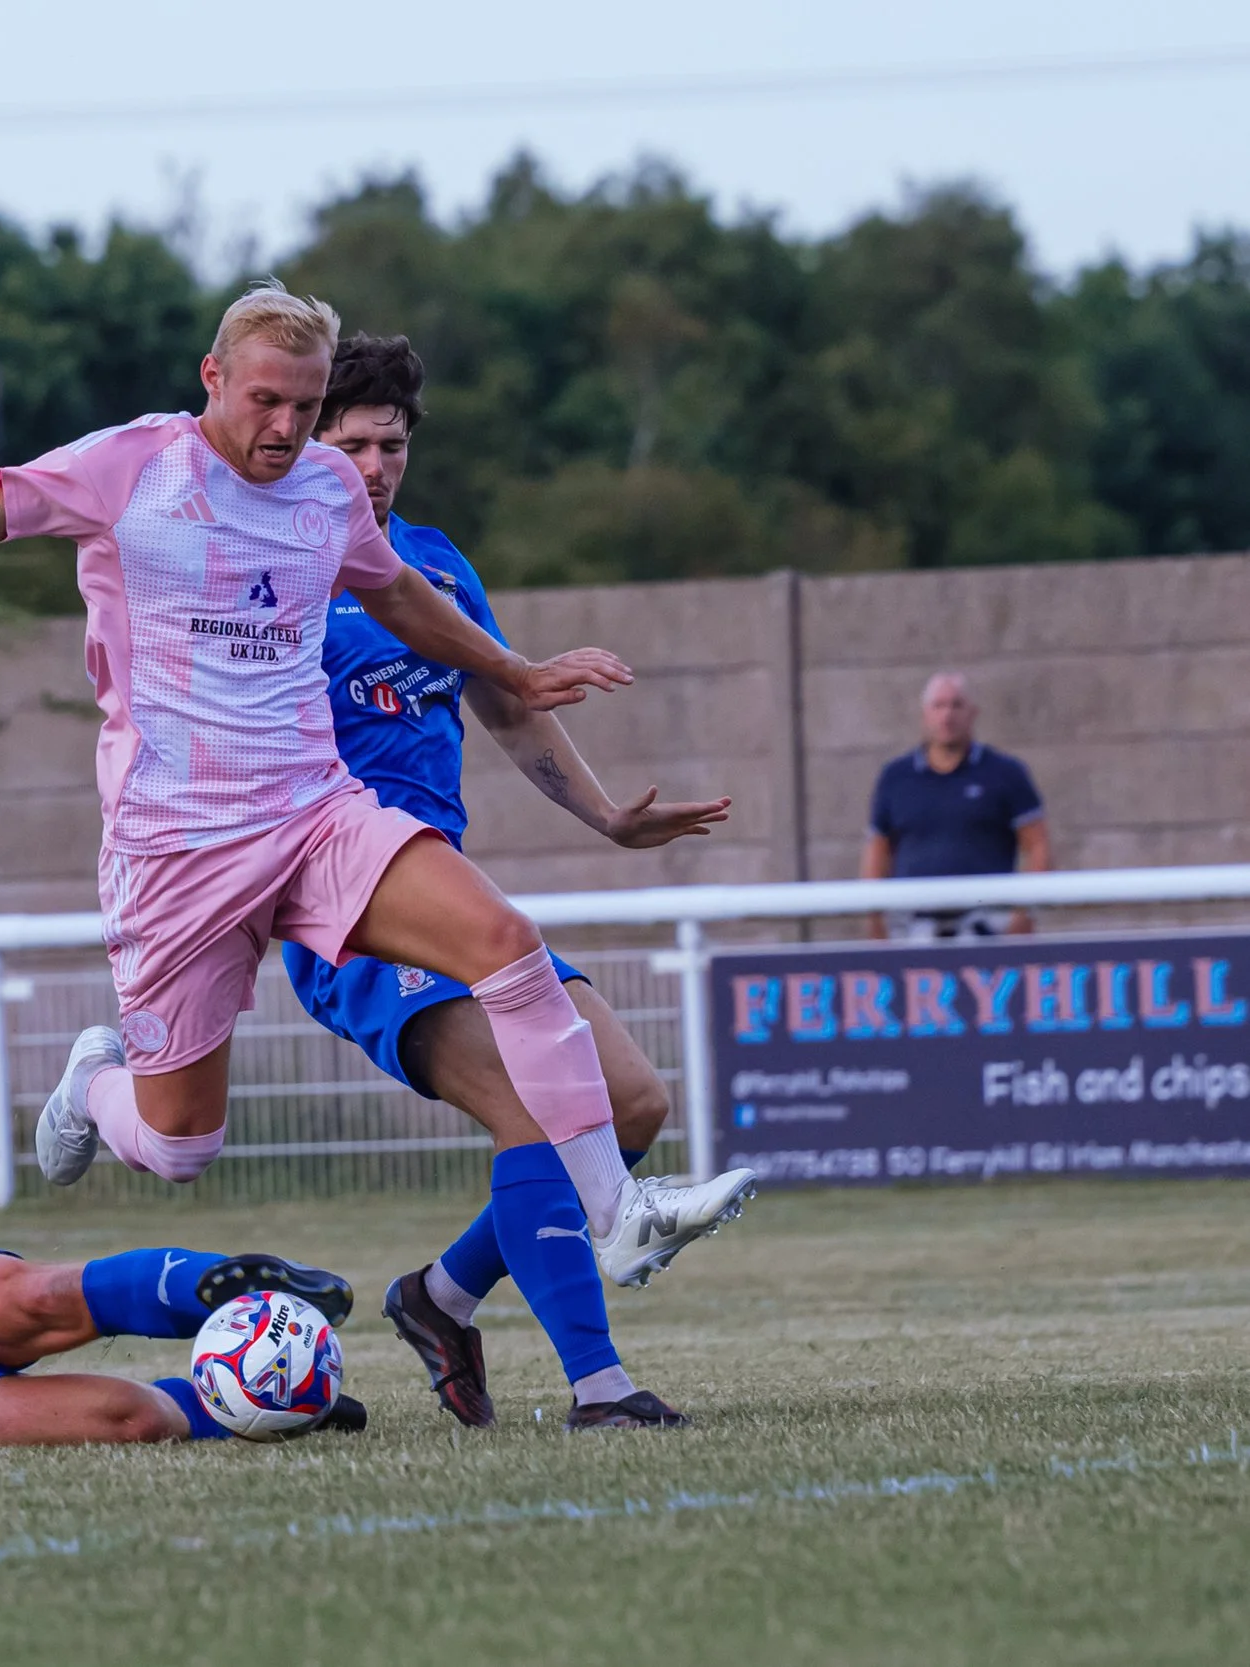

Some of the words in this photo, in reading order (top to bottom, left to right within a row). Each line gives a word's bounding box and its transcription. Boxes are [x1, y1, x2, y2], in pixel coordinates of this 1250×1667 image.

[335, 606, 360, 615] IRLAM
[190, 618, 259, 640] REGIONAL
[230, 642, 250, 659] UK
[252, 645, 280, 662] LTD.
[732, 957, 1247, 1044] FERRYHILL
[982, 1058, 1070, 1106] Fish
[1075, 1055, 1145, 1104] and
[1151, 1053, 1250, 1110] chips
[267, 1304, 290, 1348] Mitre
